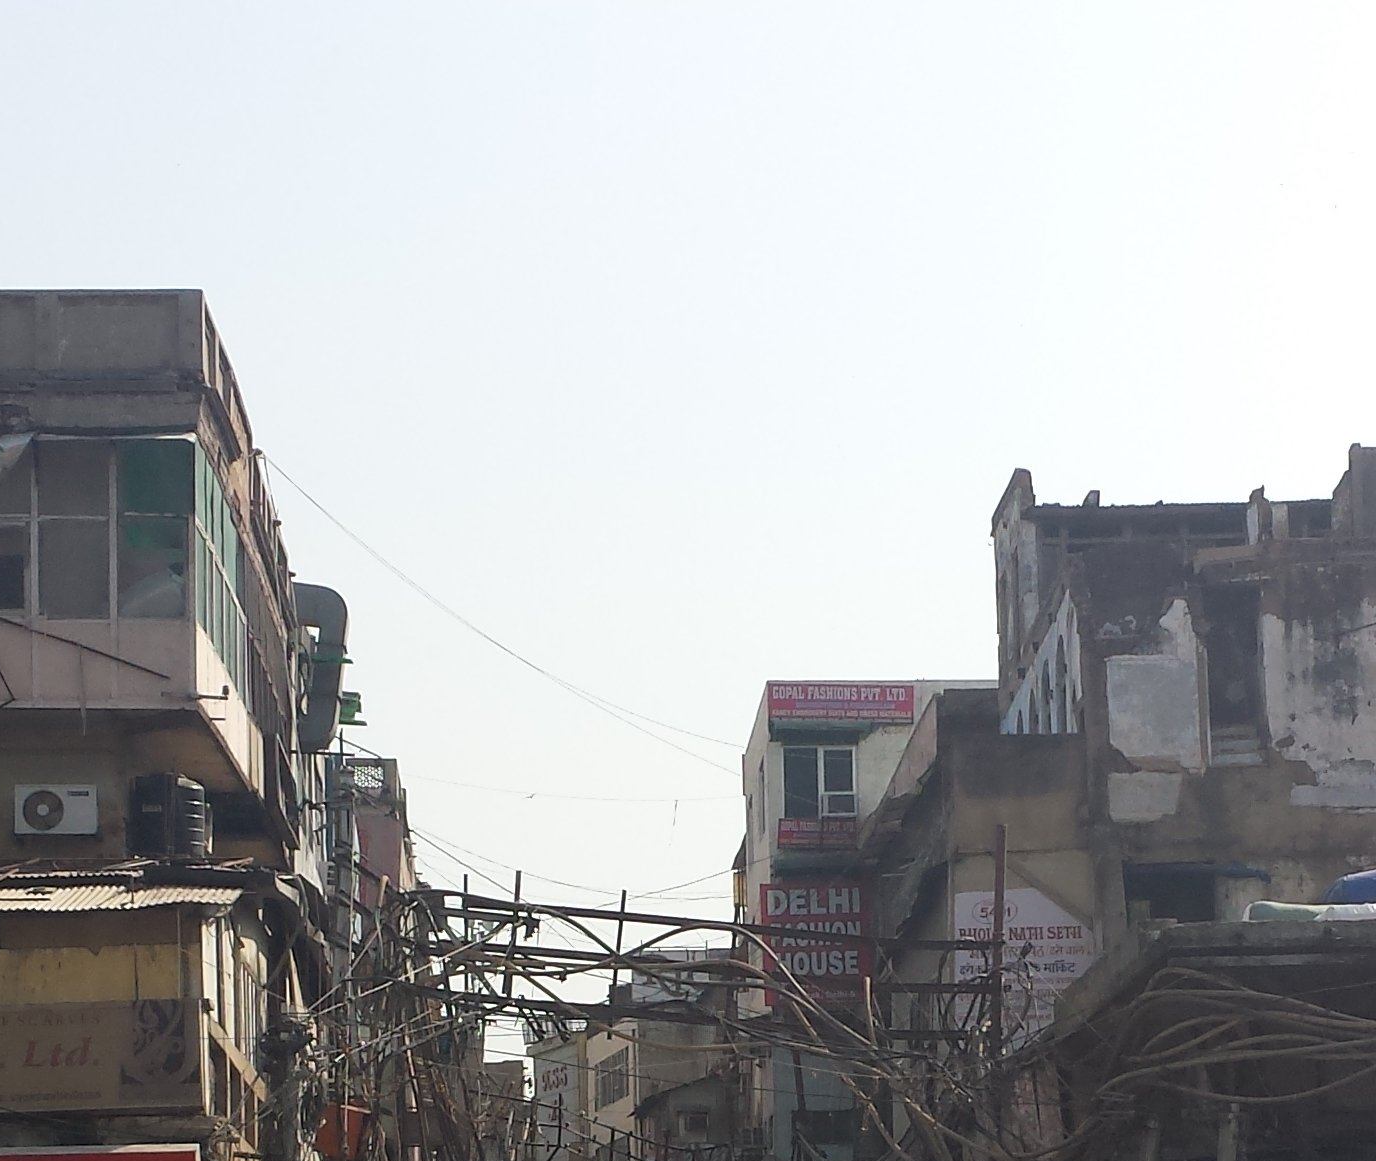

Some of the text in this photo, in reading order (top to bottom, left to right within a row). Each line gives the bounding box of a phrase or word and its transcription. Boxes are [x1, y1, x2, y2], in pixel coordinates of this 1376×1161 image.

[772, 686, 804, 700] GOPAL
[808, 686, 857, 701] FASHIONS
[767, 887, 860, 915] DELHI
[1009, 926, 1044, 941] NATH
[1047, 925, 1083, 940] SETH
[776, 951, 859, 975] HOUSE
[22, 1034, 100, 1068] Ltd.
